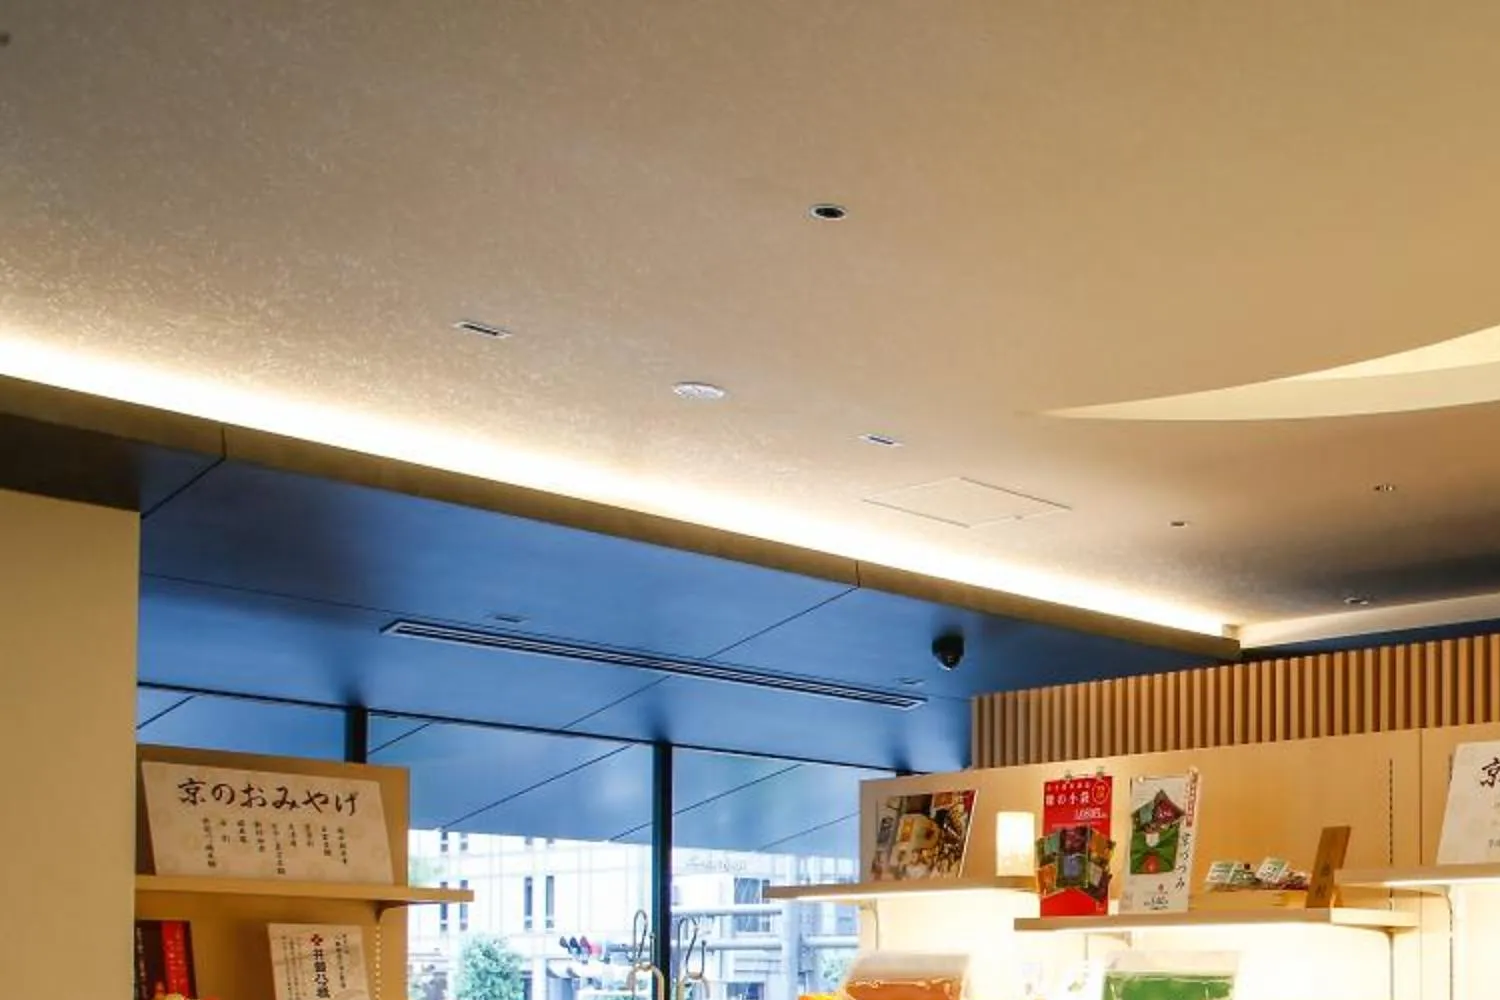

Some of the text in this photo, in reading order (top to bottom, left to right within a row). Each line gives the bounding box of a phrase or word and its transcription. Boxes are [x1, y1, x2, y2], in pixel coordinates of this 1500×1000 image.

[178, 777, 360, 817] 京のおみやげ
